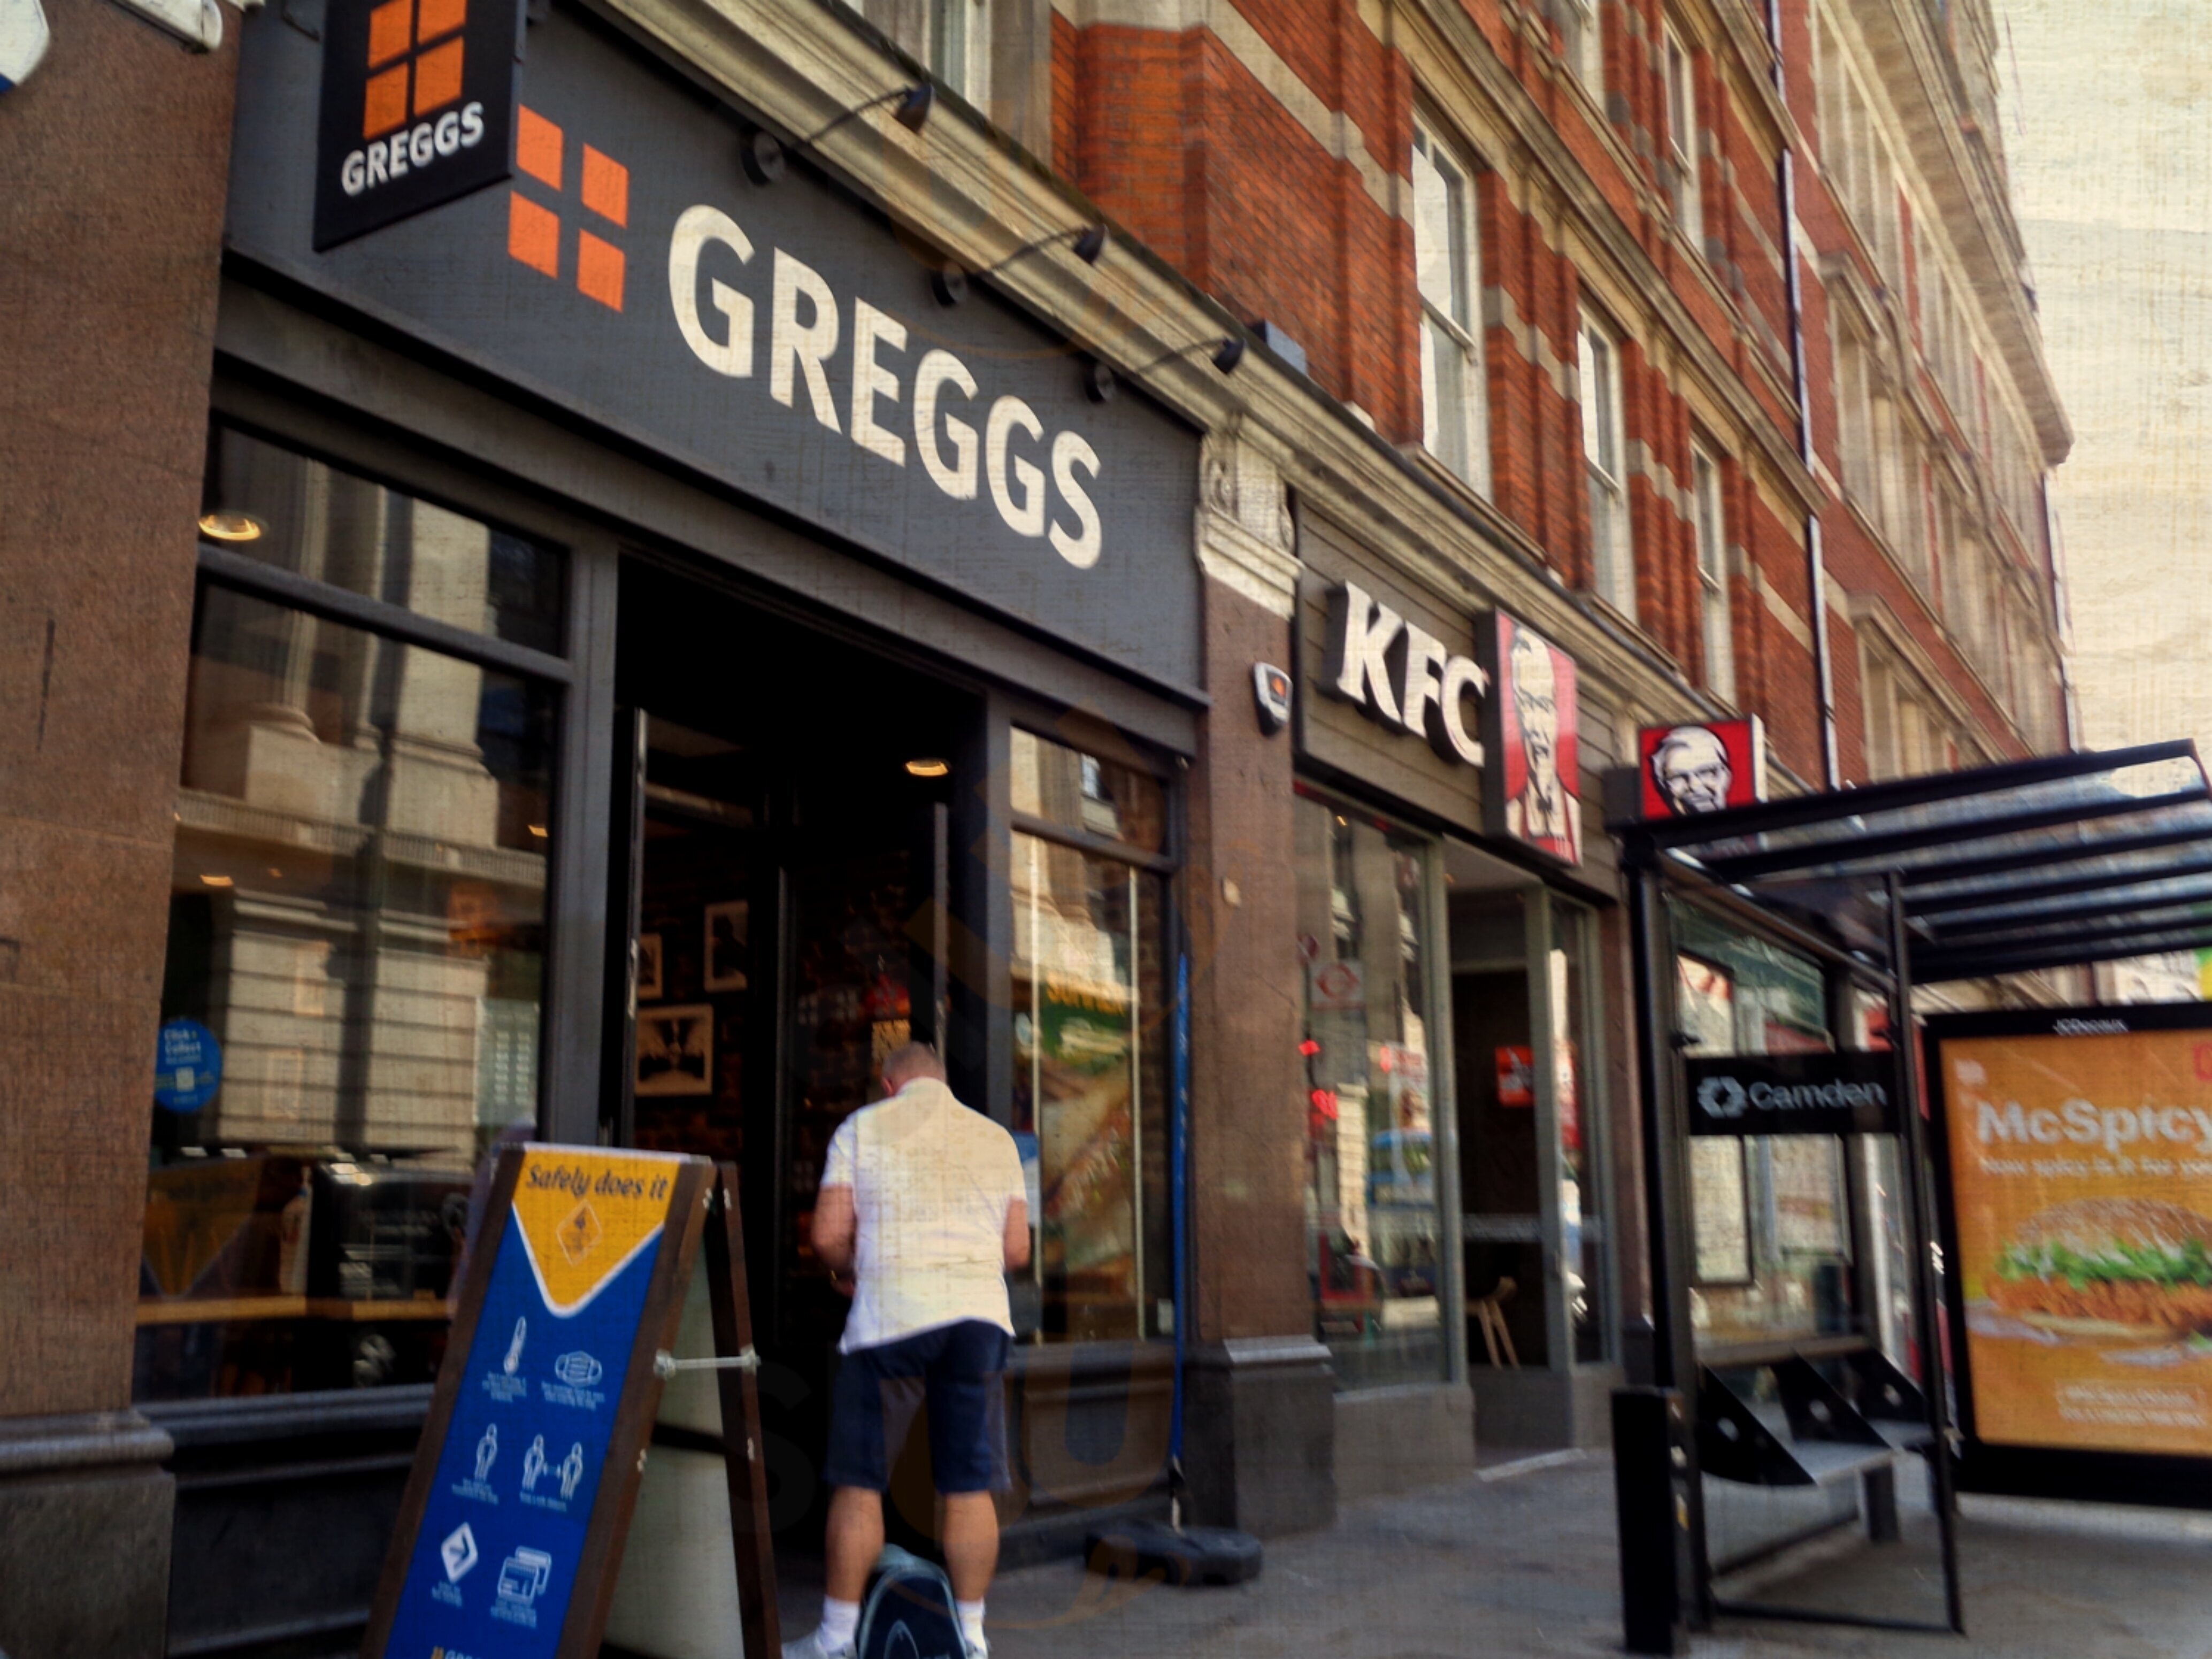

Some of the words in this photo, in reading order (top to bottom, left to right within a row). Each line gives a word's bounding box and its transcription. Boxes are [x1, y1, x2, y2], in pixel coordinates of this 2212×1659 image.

[341, 102, 485, 196] GREGGS
[668, 204, 1102, 570] GREGGS
[1337, 579, 1487, 768] KFC
[1748, 1078, 1888, 1111] Camden
[526, 1164, 591, 1198] Safely
[594, 1169, 644, 1200] does
[649, 1173, 668, 1201] it
